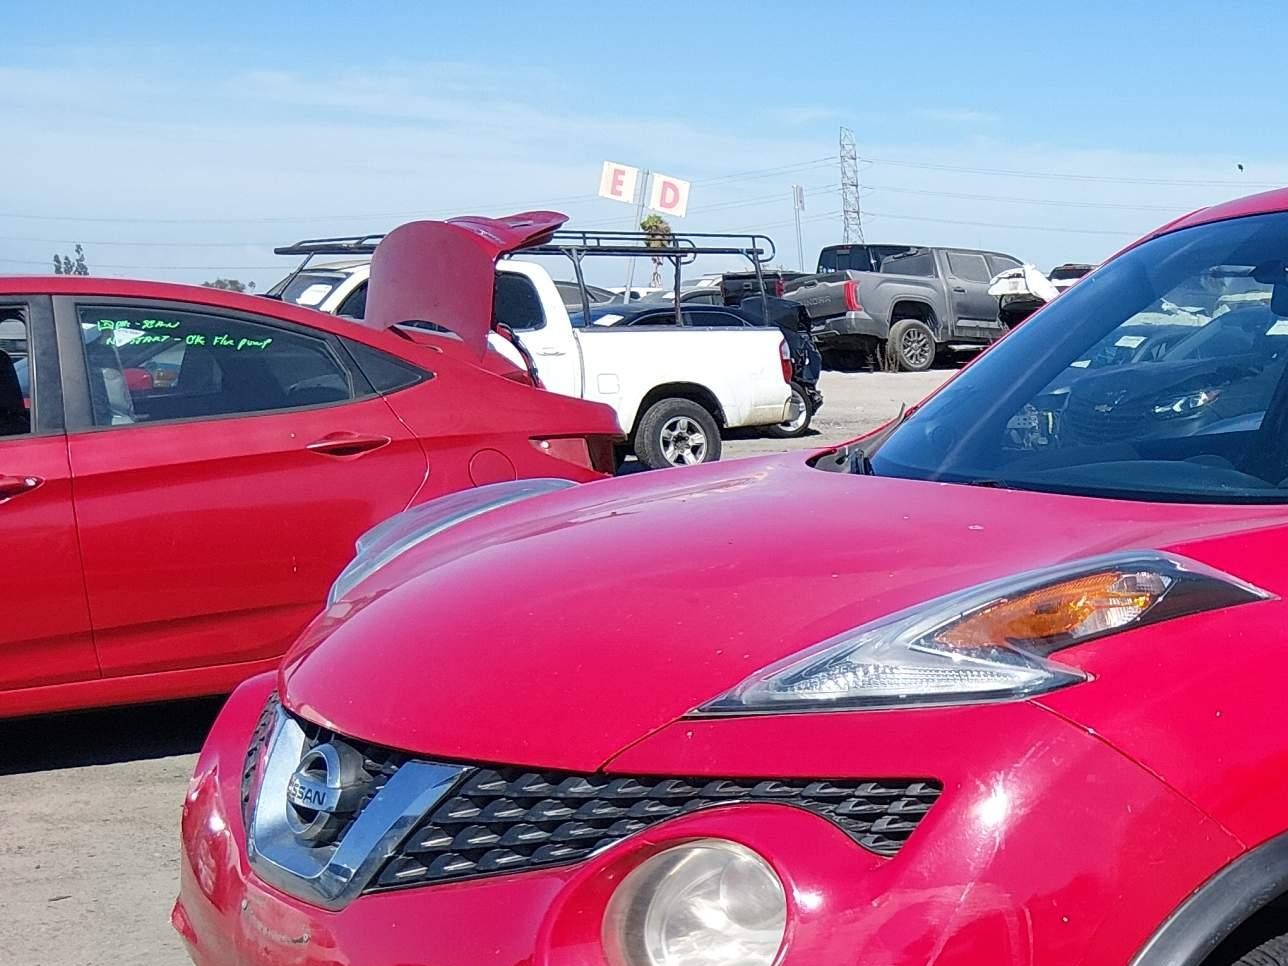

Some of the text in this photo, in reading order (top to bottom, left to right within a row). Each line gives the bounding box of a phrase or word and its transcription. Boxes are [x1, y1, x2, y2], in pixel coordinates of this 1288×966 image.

[610, 168, 626, 197] E
[659, 180, 680, 209] D
[288, 780, 327, 806] SSAN
